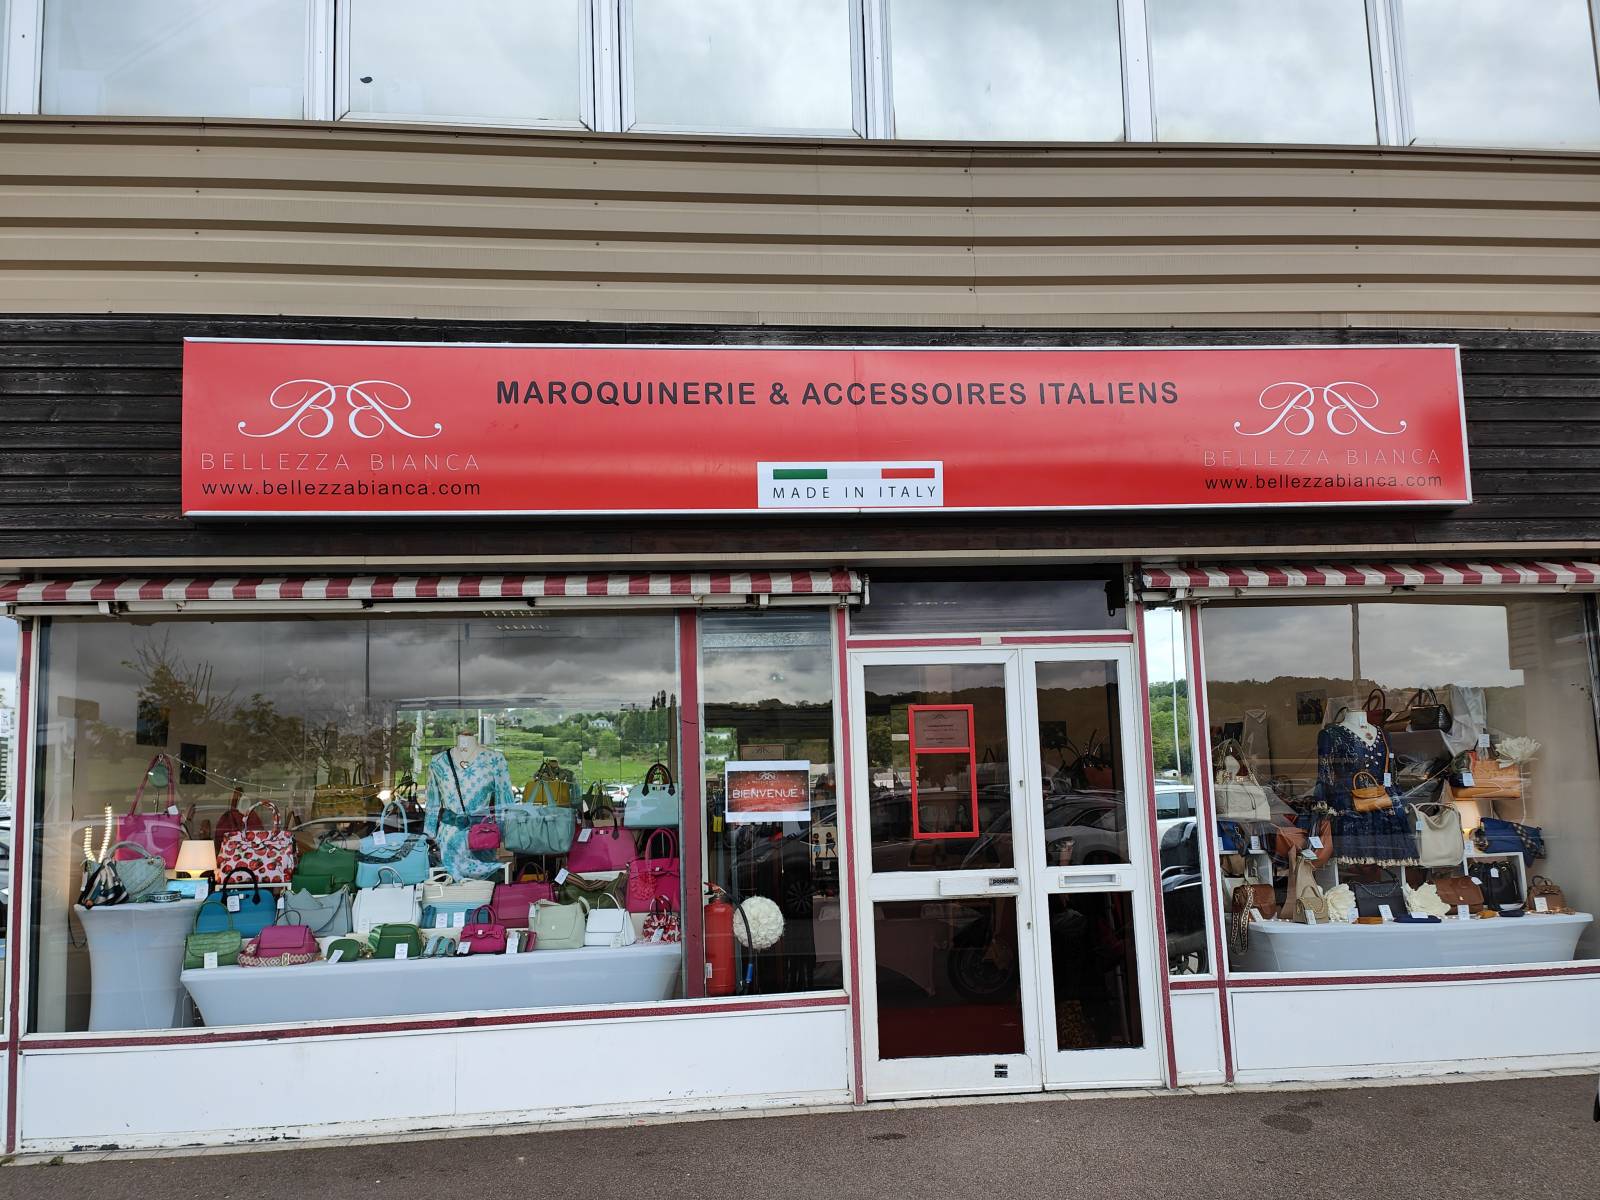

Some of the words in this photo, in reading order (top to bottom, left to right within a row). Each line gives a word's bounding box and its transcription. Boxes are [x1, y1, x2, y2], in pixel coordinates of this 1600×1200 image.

[497, 381, 756, 405] MAROQUINERIE
[769, 382, 789, 405] &
[802, 382, 1027, 405] ACCESSOIRES
[1039, 381, 1178, 404] ITALIENS
[201, 453, 350, 471] BELLEZZA
[370, 454, 480, 471] BIANCA
[1204, 450, 1329, 467] BELLEZZA
[1347, 448, 1441, 465] BIANCA
[202, 479, 481, 496] www.bellezzabianca.com
[1205, 474, 1442, 490] www.bellezzabianca.com
[773, 486, 830, 499] MADE
[845, 486, 864, 498] IN
[879, 485, 936, 498] ITALY
[733, 788, 798, 799] BIENVENUE
